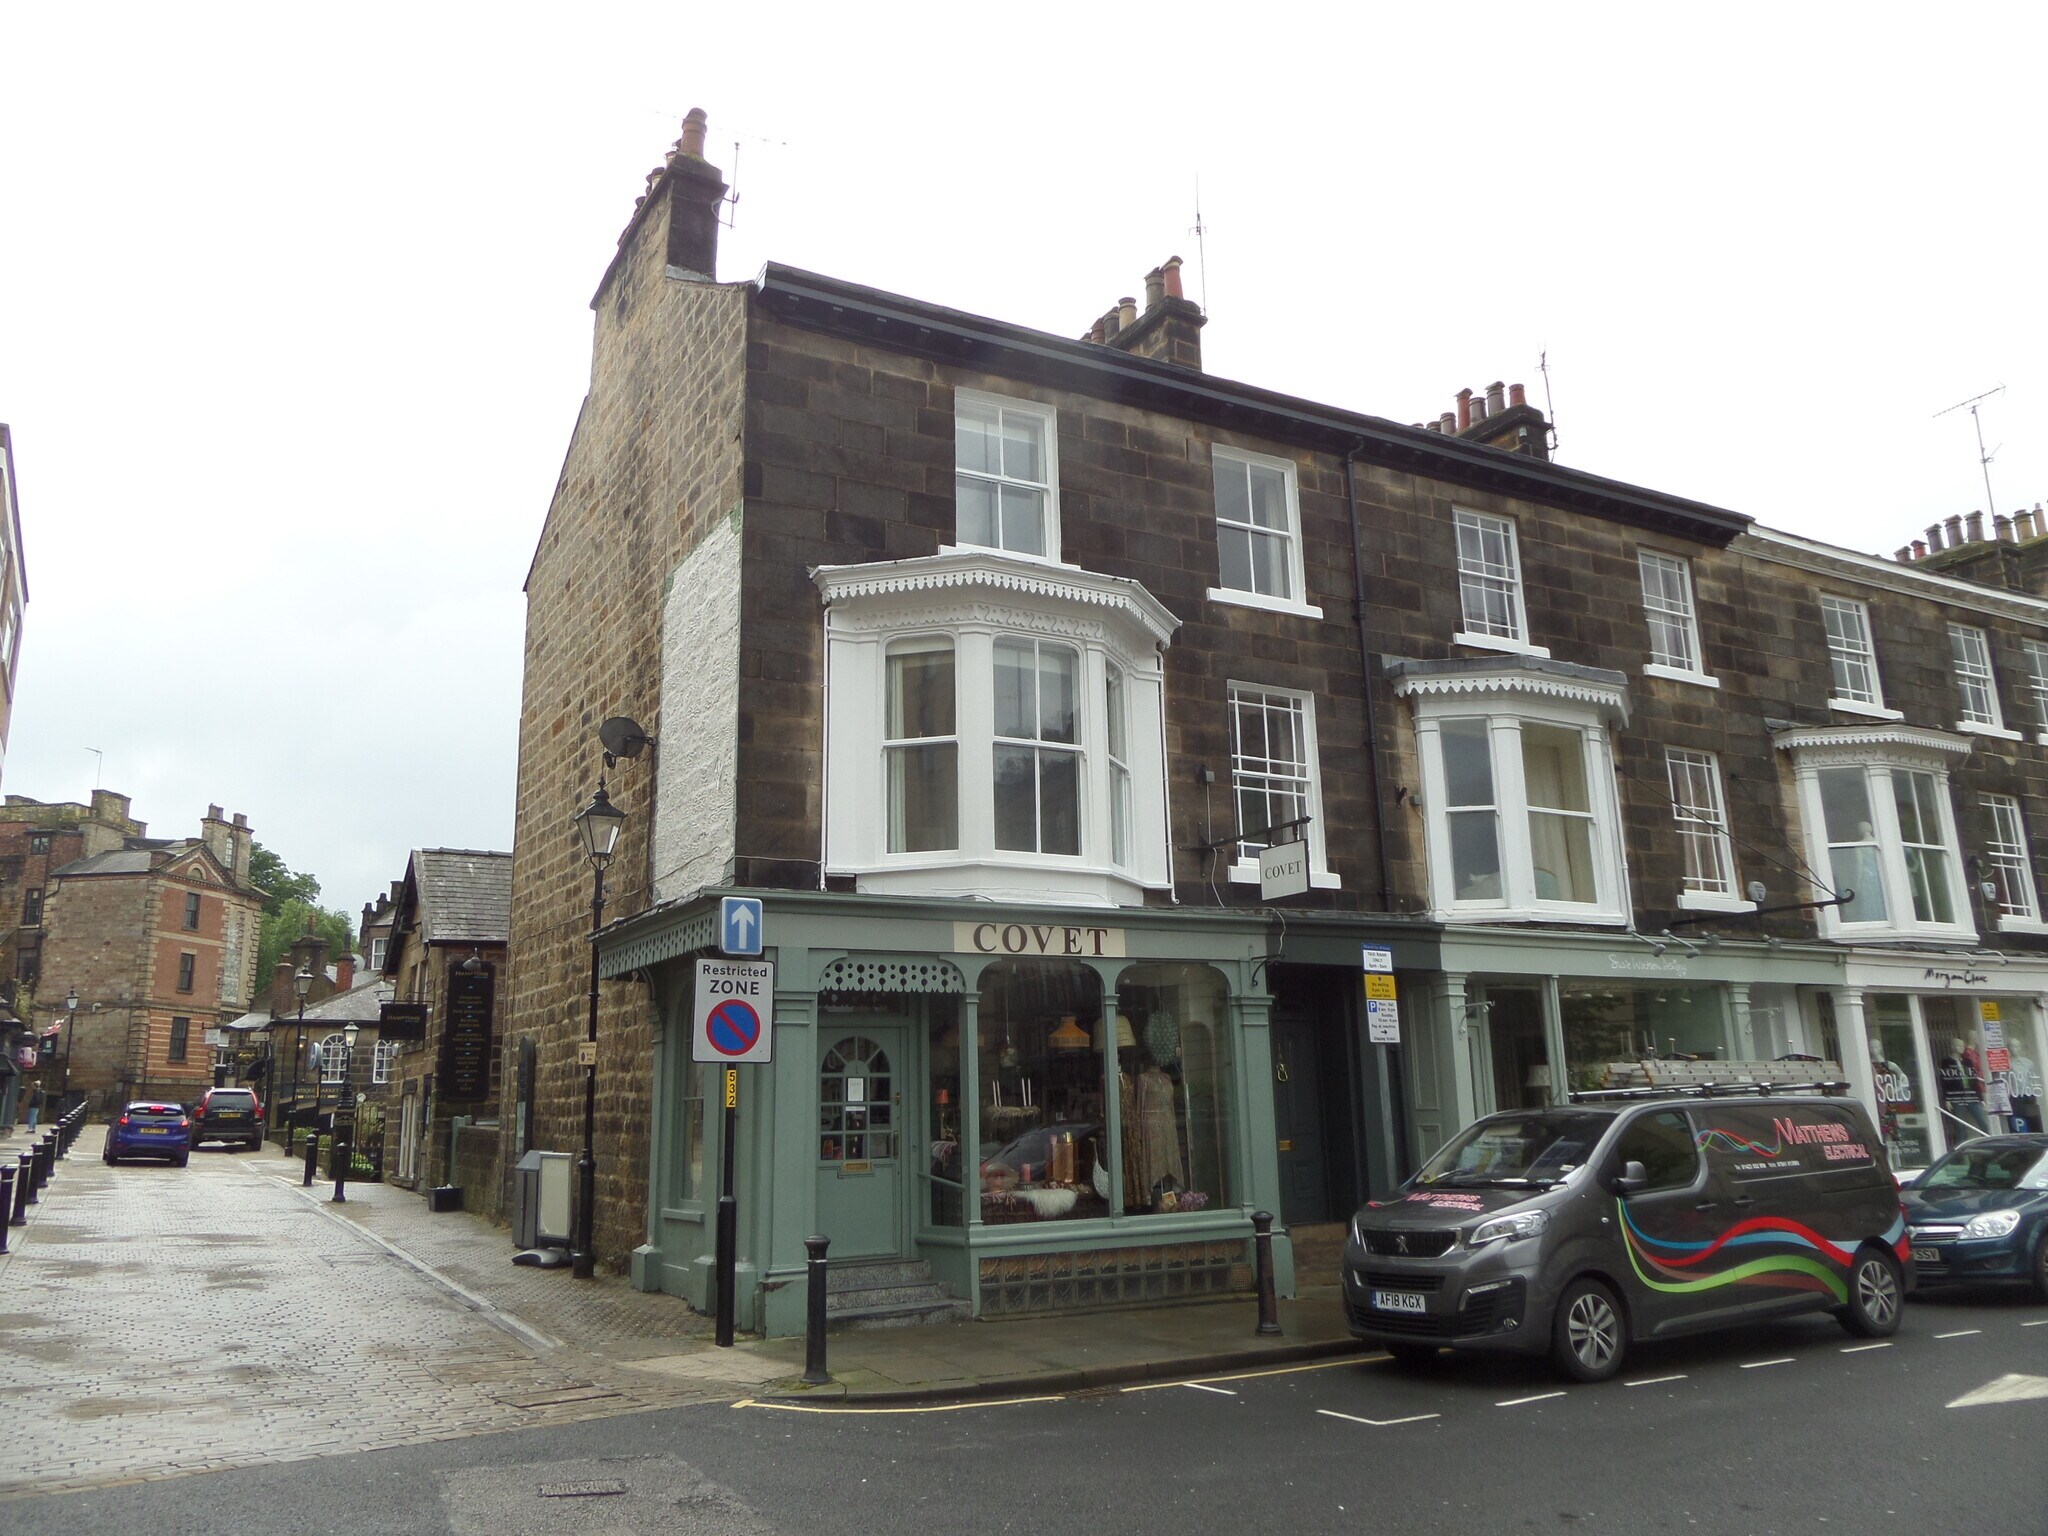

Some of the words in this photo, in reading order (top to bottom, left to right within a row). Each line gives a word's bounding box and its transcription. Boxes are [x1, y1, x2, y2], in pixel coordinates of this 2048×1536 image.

[1265, 860, 1302, 880] COVET
[973, 923, 1107, 956] COVET
[702, 964, 768, 977] Restricted
[1924, 968, 1964, 989] Morgan
[709, 980, 760, 995] ZONE
[1370, 1001, 1376, 1011] P
[1940, 1067, 1977, 1077] VOGUE
[728, 1072, 736, 1106] 532
[1876, 1074, 1911, 1102] sale
[1774, 1117, 1849, 1145] MATTHEWS
[2015, 1118, 2025, 1132] P
[1823, 1144, 1869, 1160] ELECTRICAL
[1380, 1293, 1400, 1306] AF18
[1402, 1295, 1421, 1310] KGX
